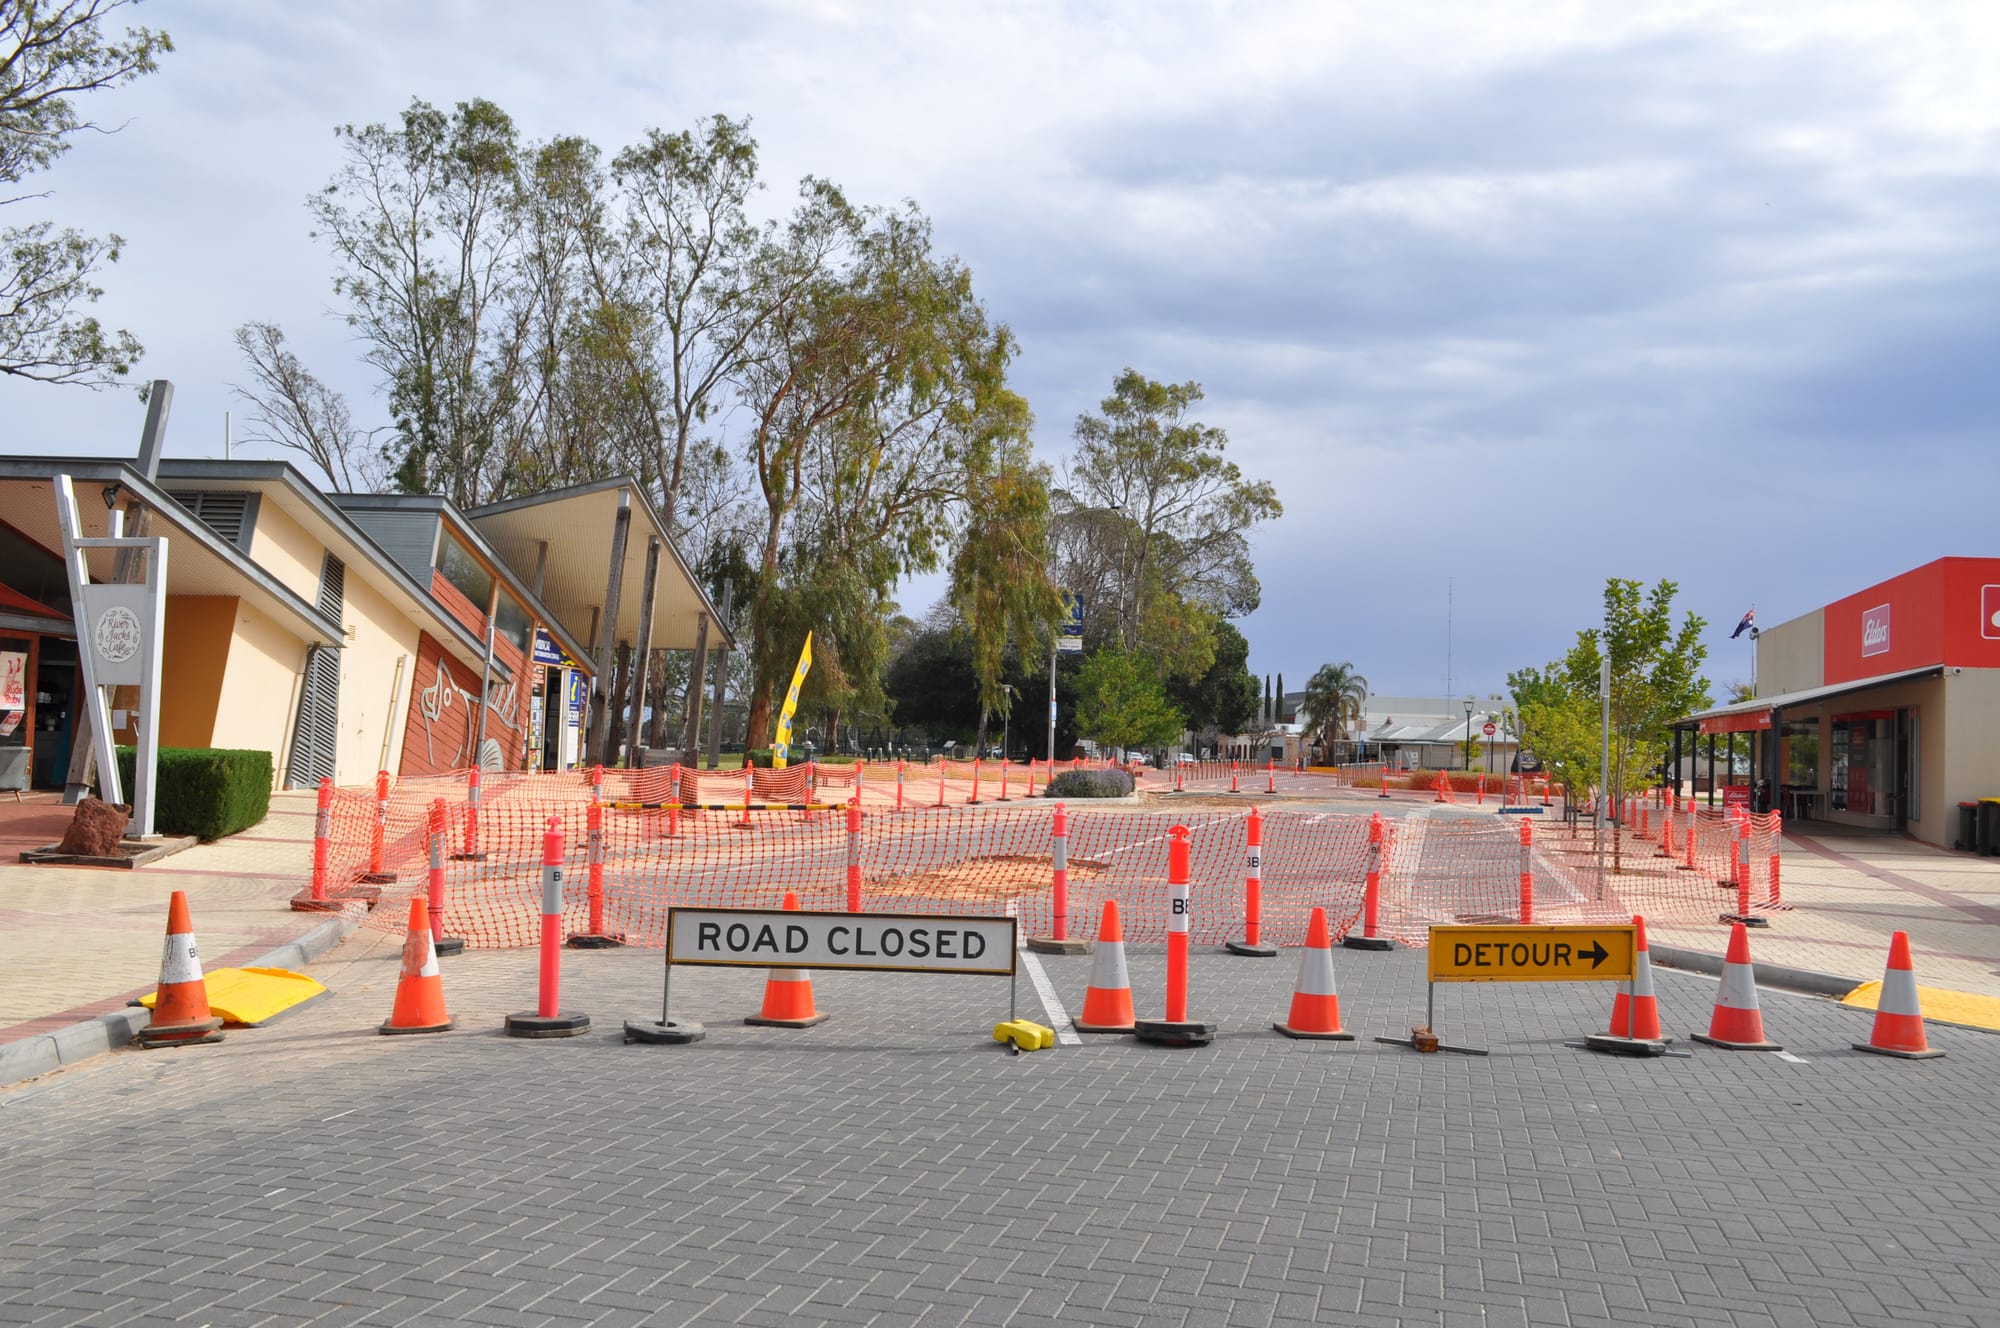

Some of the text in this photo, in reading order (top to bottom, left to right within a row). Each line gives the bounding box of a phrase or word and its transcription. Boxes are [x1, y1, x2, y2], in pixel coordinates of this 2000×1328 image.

[108, 617, 130, 630] River
[1864, 618, 1888, 647] Elders
[105, 629, 131, 642] Jacks
[553, 871, 563, 881] B
[697, 922, 986, 960] ROAD CLOSED
[1454, 943, 1572, 967] DETOUR
